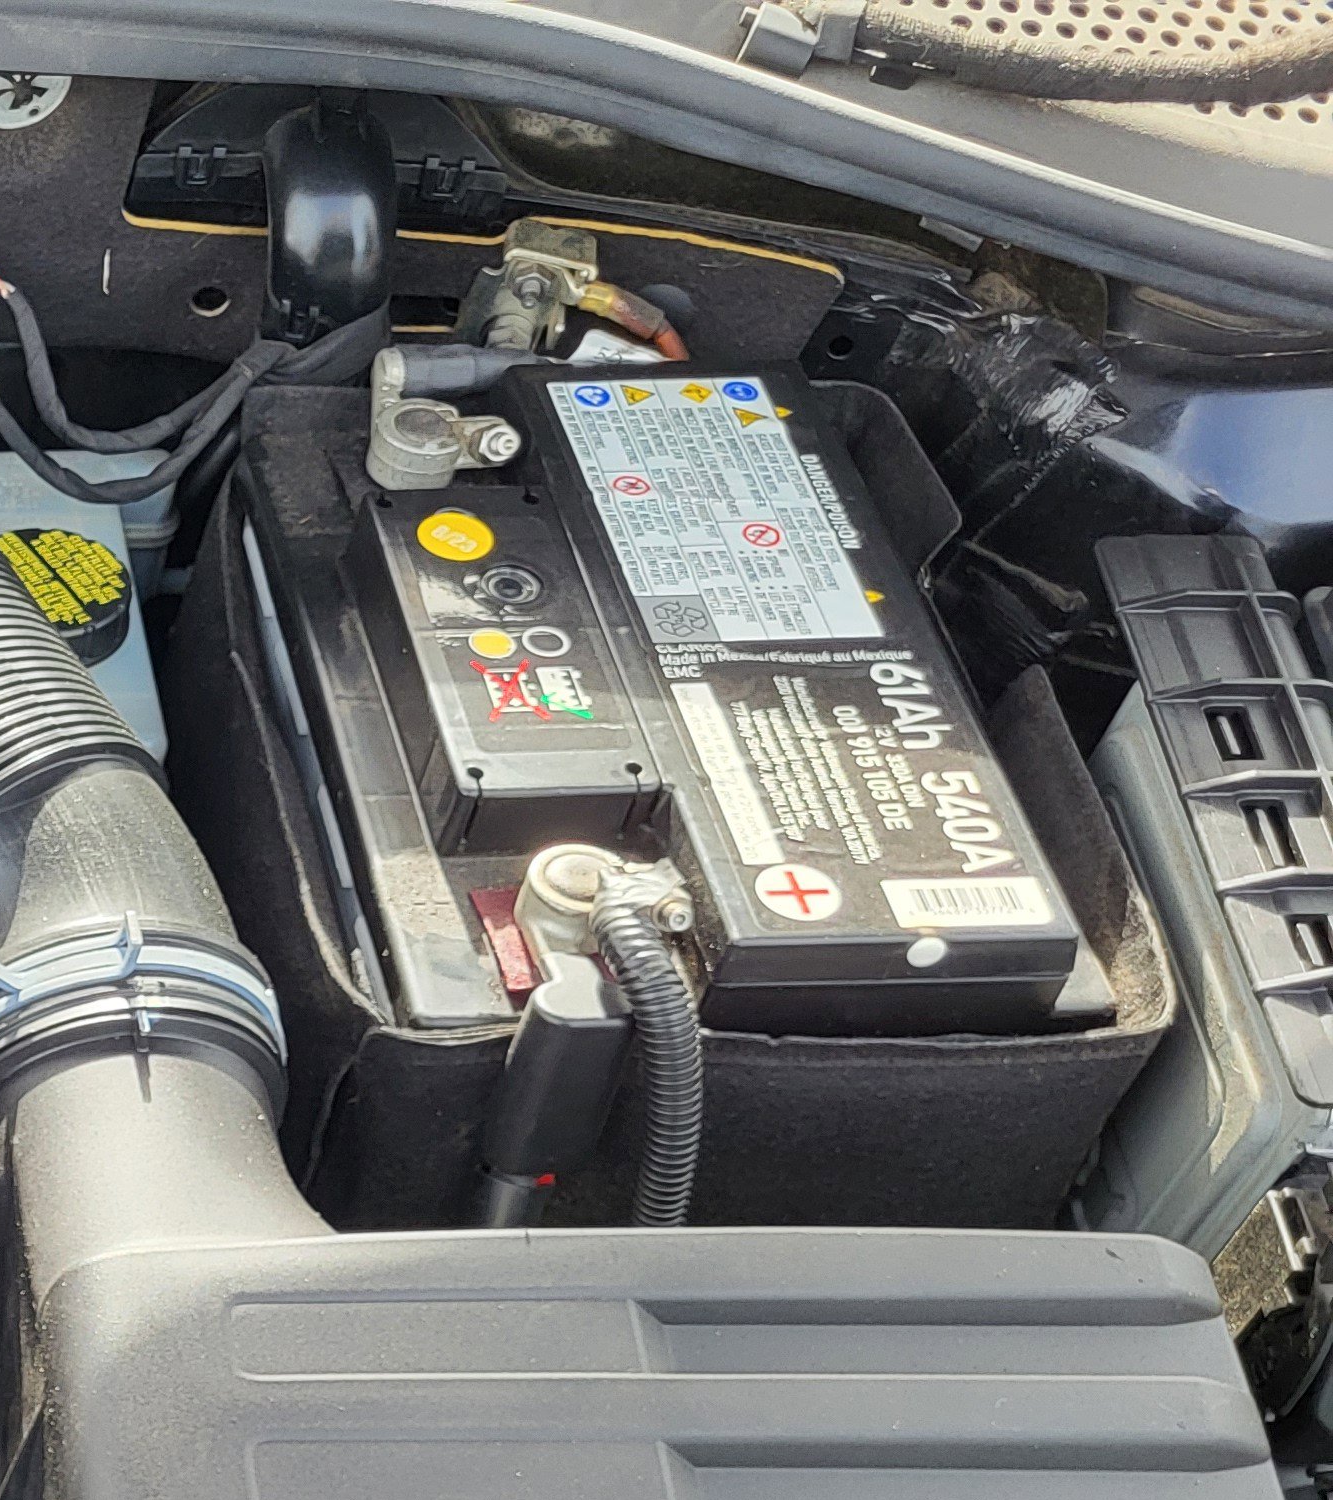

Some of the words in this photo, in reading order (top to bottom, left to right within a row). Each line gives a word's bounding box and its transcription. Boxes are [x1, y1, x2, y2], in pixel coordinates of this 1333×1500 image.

[800, 453, 862, 549] DANGER/POISON
[658, 652, 700, 666] Made
[853, 650, 914, 662] Mexique
[661, 664, 704, 679] EMC
[846, 736, 883, 769] 915
[869, 662, 953, 750] 61Ah
[921, 770, 1015, 874] 540A
[862, 771, 899, 802] 105
[877, 803, 913, 831] DE
